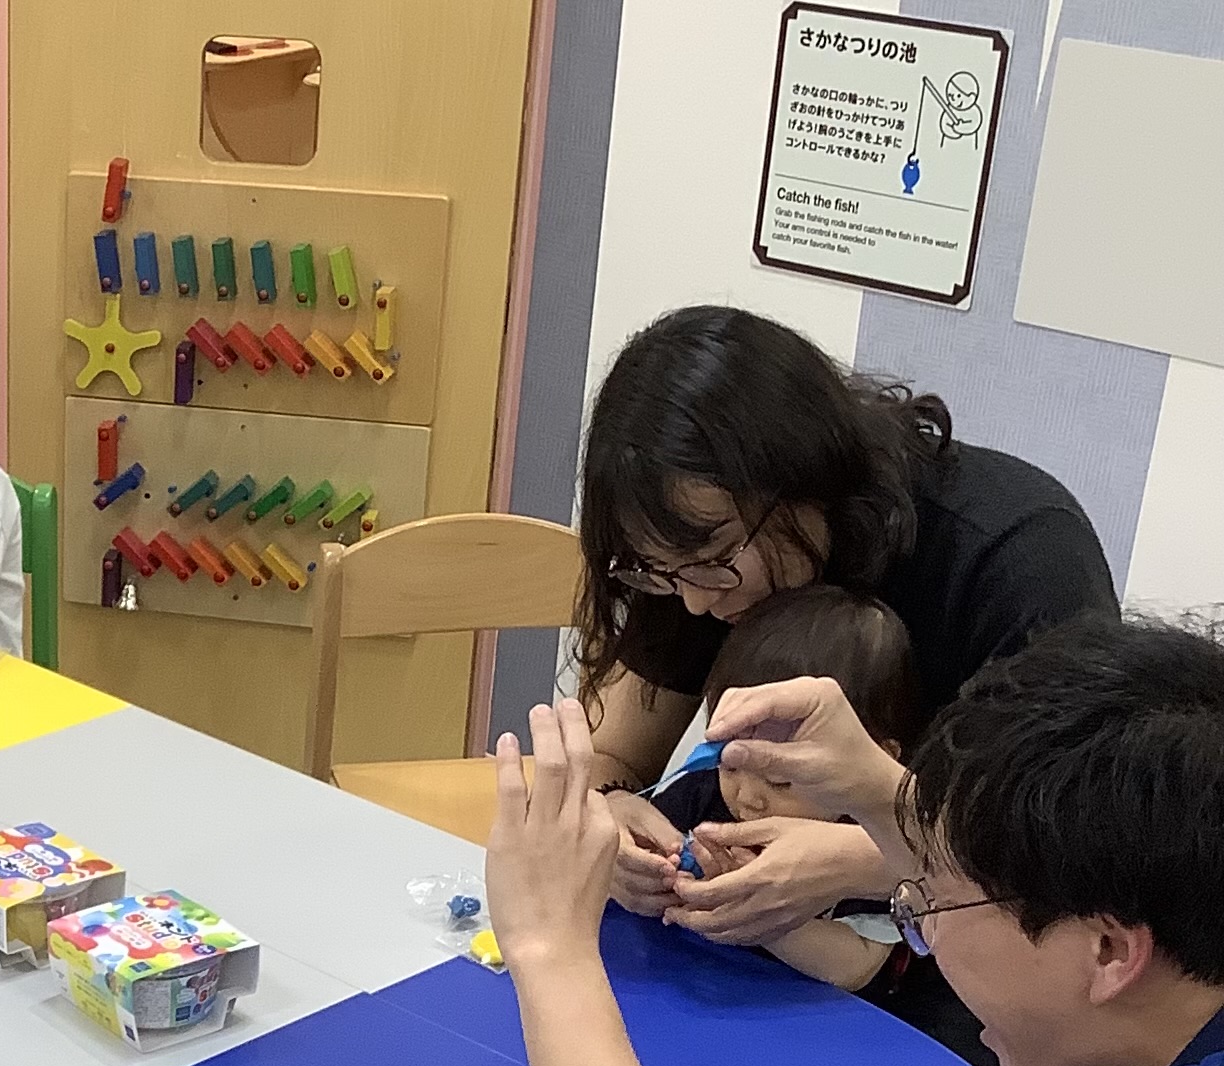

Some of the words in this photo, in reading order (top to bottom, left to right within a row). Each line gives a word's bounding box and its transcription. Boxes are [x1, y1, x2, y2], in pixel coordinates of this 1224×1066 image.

[799, 27, 917, 64] さかなつりの池
[792, 83, 909, 113] さかなの口の輪っかに、つり
[790, 101, 905, 131] ざおの針をひっかけてつりあ
[785, 137, 886, 164] コントロールできるかな？
[777, 187, 811, 205] Catch
[813, 194, 832, 209] the
[834, 198, 860, 214] fish!
[774, 219, 790, 229] Your
[791, 224, 805, 232] arm
[806, 227, 831, 237] control
[832, 231, 838, 239] is
[840, 234, 867, 245] needed
[868, 238, 876, 247] to
[775, 206, 793, 218] Grab
[794, 210, 805, 220] the
[806, 212, 829, 226] fishing
[831, 218, 847, 228] rods
[848, 223, 863, 231] and
[863, 225, 884, 235] catch
[885, 229, 897, 238] the
[898, 231, 912, 241] fish
[913, 233, 920, 242] in
[921, 236, 933, 245] the
[772, 232, 791, 242] catch
[792, 237, 809, 245] your
[809, 239, 835, 251] favorite
